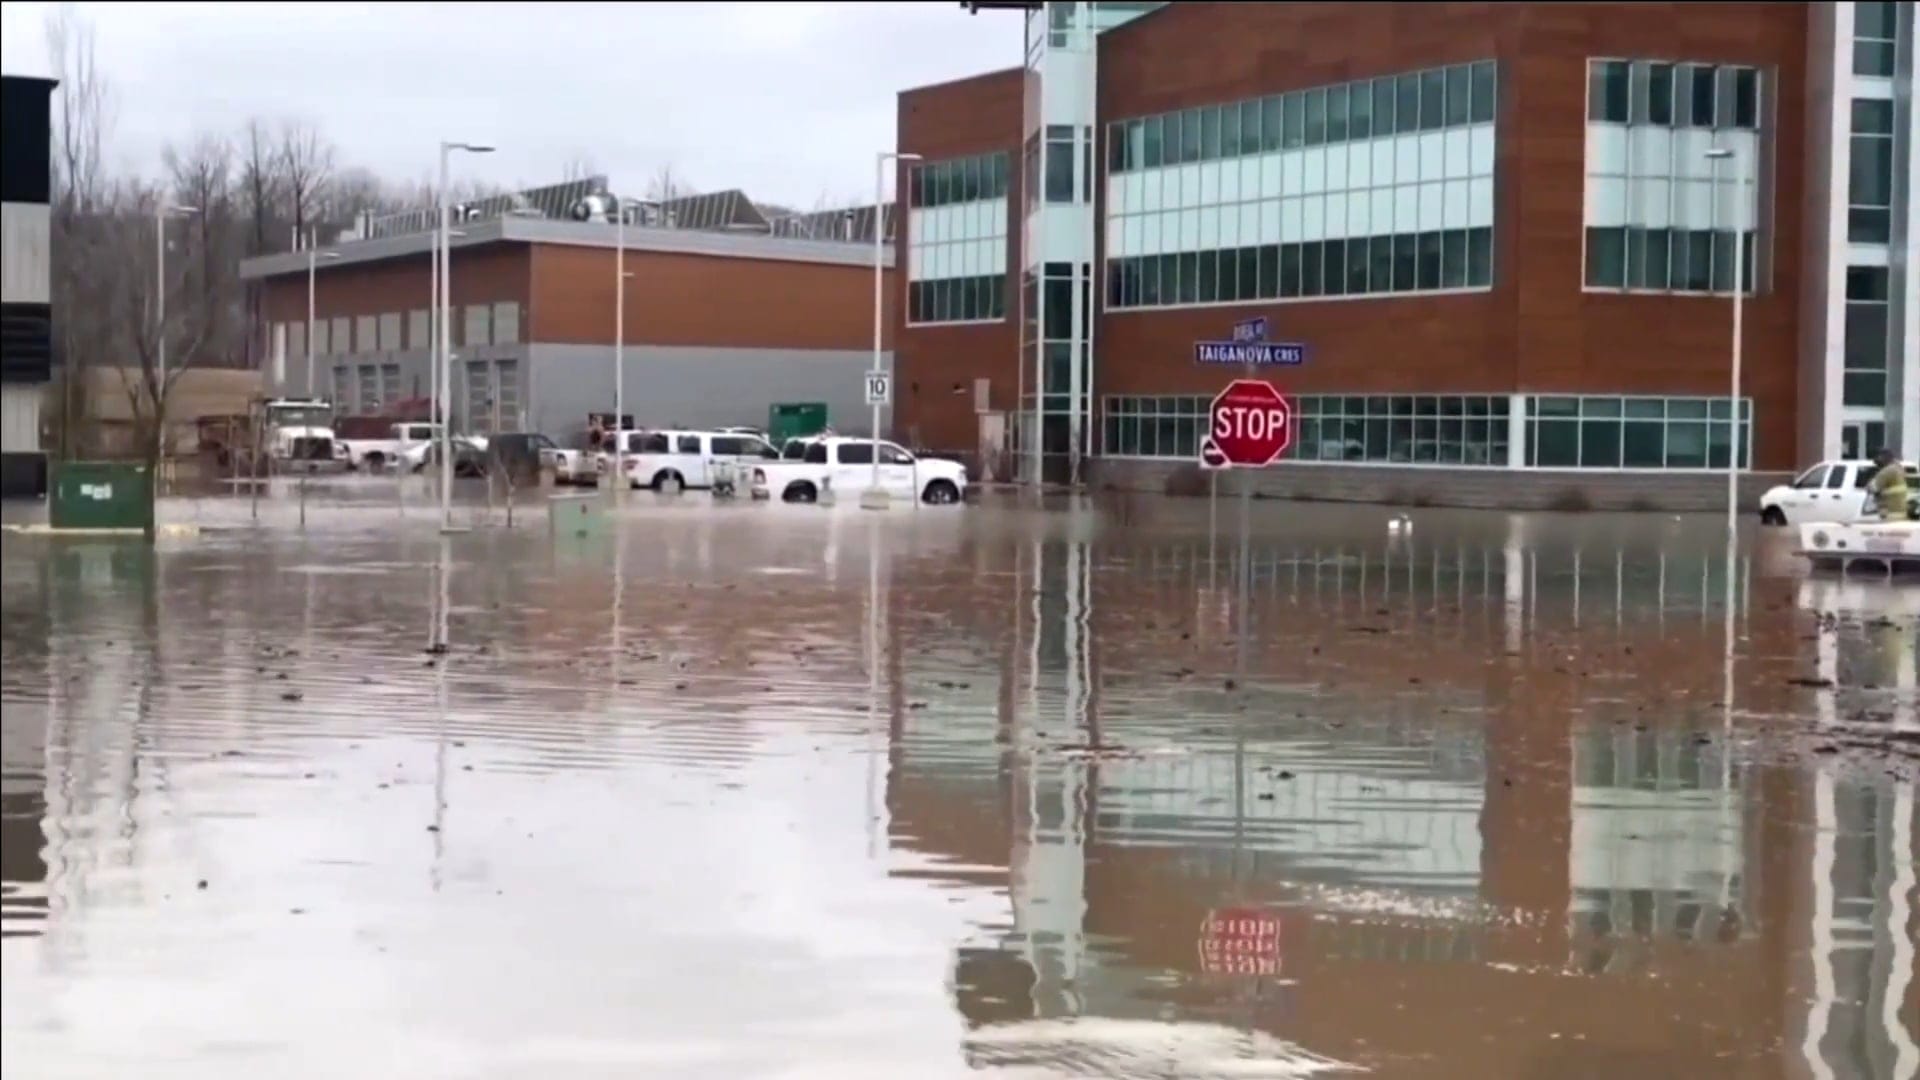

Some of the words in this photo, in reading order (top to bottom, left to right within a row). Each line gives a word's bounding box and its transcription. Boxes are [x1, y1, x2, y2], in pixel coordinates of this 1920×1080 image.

[1199, 345, 1272, 363] TAIGANOVA
[1274, 349, 1300, 362] CRES
[870, 378, 886, 396] 10
[1215, 406, 1285, 441] STOP
